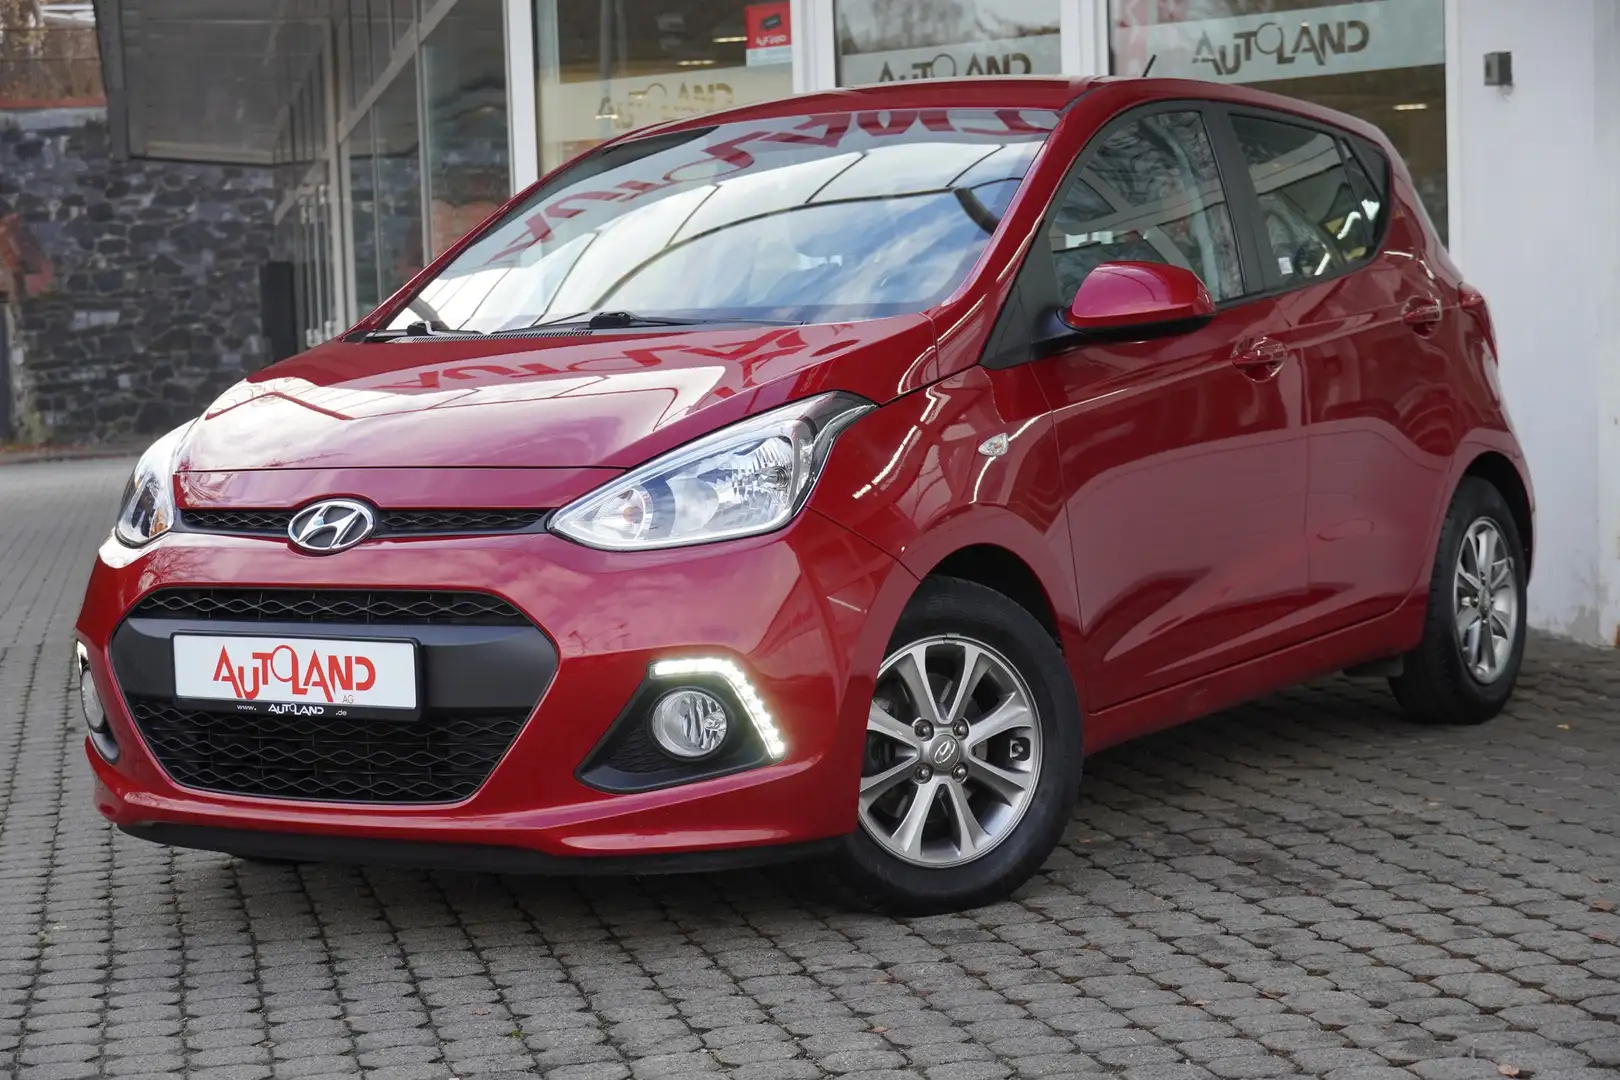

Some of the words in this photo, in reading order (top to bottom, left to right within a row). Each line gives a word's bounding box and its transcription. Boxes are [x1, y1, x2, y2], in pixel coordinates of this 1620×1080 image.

[1192, 20, 1370, 75] AUTOLAND
[879, 52, 1032, 82] ATOAND
[213, 645, 376, 702] AUTOLAND
[236, 703, 257, 711] www.
[268, 703, 325, 716] AUTOLAND
[342, 694, 354, 704] AG
